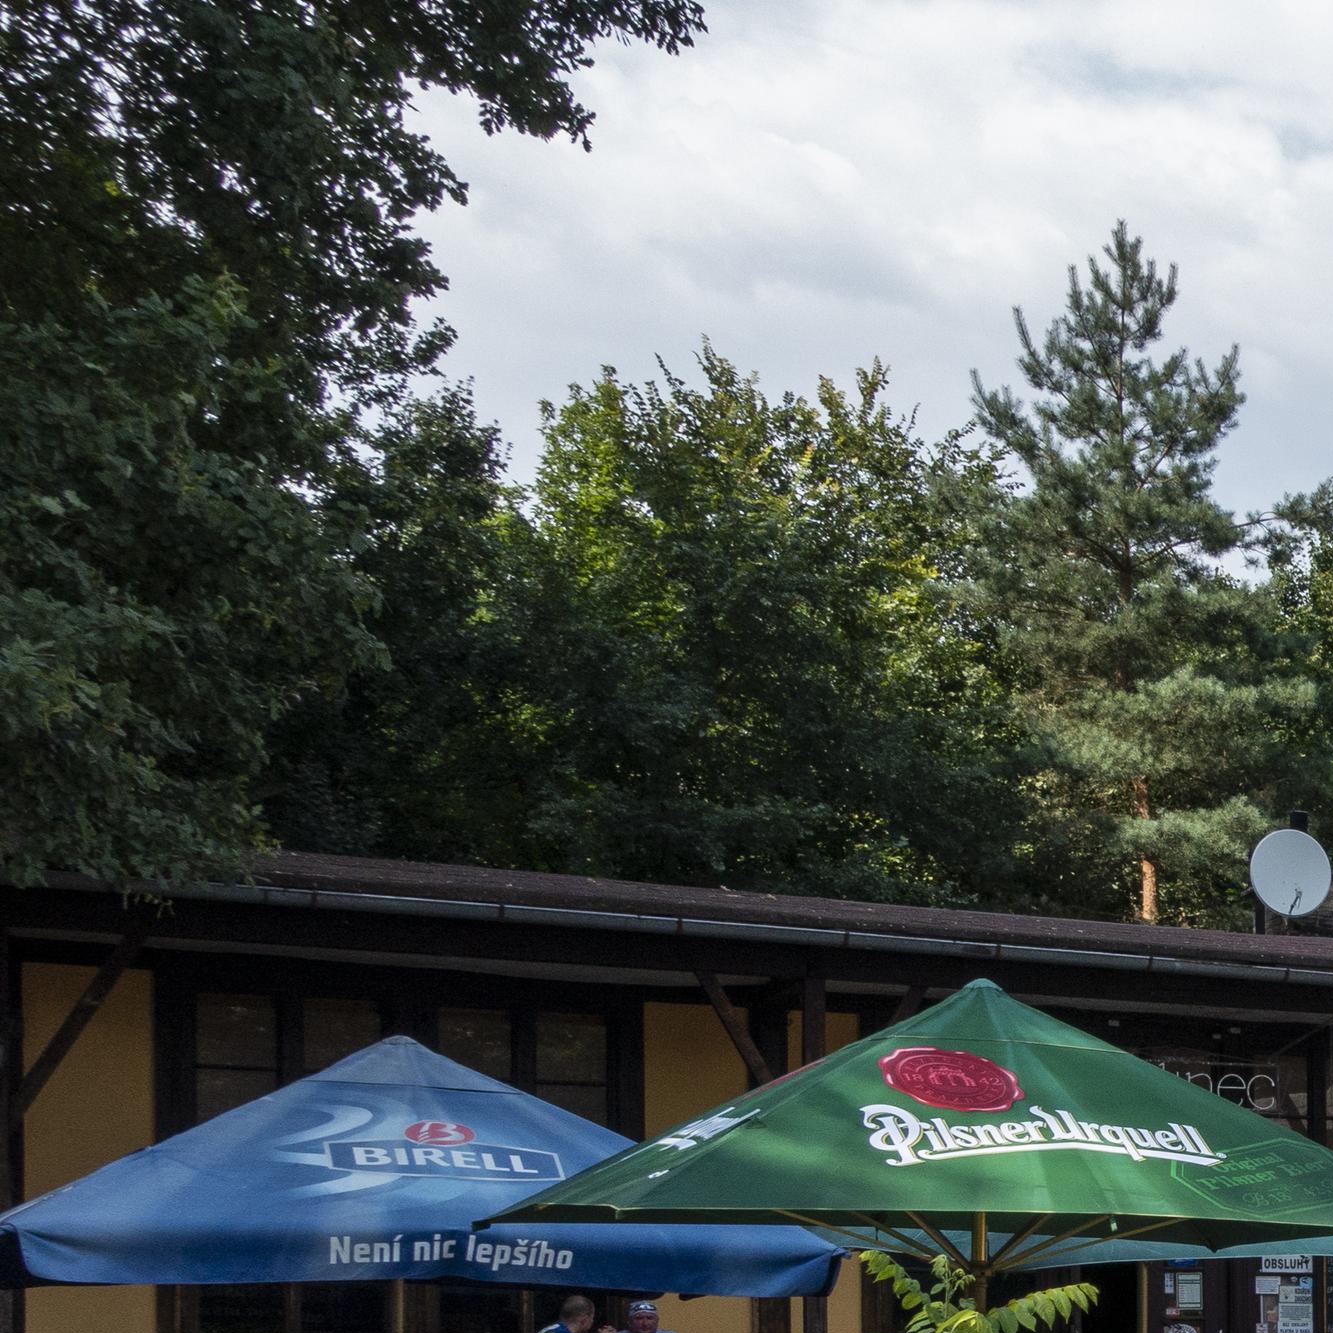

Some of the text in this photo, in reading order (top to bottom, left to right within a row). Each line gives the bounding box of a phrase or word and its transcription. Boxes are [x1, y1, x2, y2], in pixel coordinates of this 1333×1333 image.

[861, 1103, 1219, 1167] Pilsner Urquell
[351, 1146, 540, 1174] BIRELL
[1197, 1158, 1330, 1191] Pilsner Bier
[329, 1233, 574, 1272] Není nic lepšího
[1264, 1258, 1310, 1270] OBSLUHY
